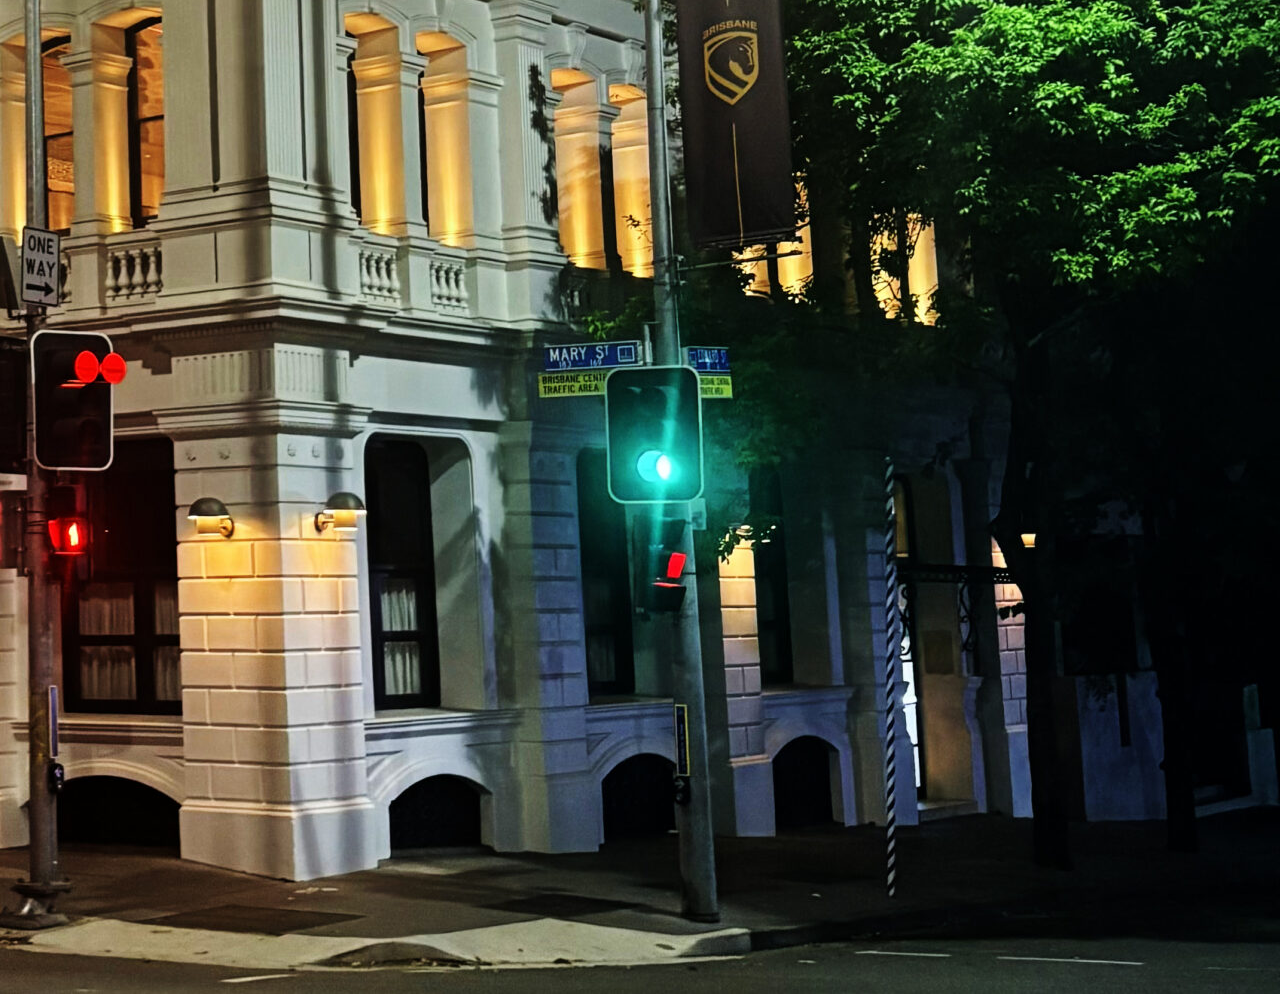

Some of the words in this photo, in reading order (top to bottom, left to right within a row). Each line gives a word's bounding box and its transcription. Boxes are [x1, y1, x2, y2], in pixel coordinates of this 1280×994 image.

[703, 19, 758, 40] BRISBANE
[28, 235, 54, 255] ONE
[26, 257, 56, 278] WAY
[549, 346, 587, 362] MARY
[542, 374, 581, 384] BRISBANE
[543, 384, 575, 394] TRAFFIC
[578, 383, 599, 392] AREA
